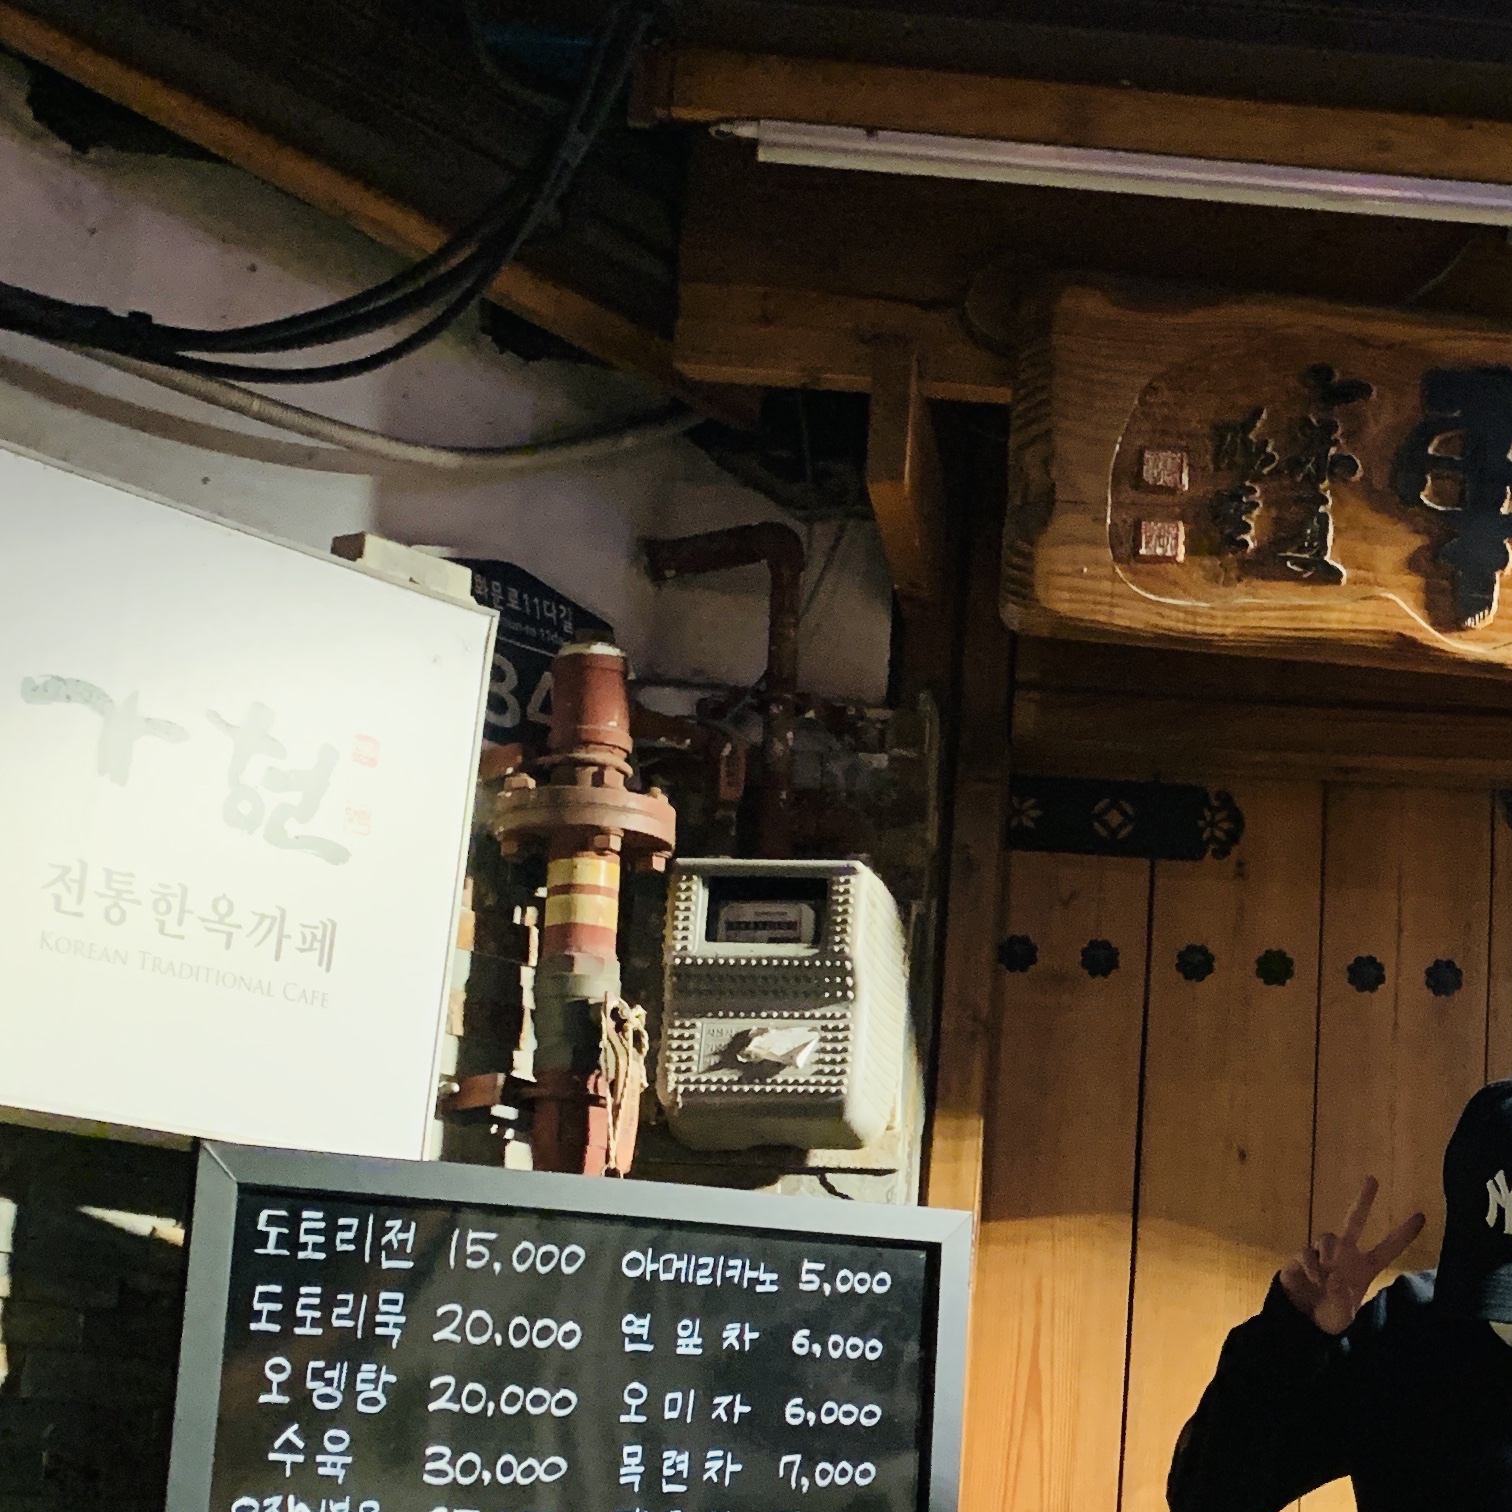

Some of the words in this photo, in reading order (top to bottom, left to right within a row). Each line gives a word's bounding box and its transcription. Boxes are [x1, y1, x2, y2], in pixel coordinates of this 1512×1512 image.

[40, 858, 339, 973] 전통한옥까페
[137, 951, 276, 998] TRADITIONAL
[282, 981, 330, 1009] CAFE
[254, 1209, 417, 1270] 도토리전
[449, 1228, 586, 1275] 15,000
[621, 1248, 779, 1294] 아메리카노
[798, 1258, 892, 1296] 5,000
[249, 1284, 406, 1350] 도토리묵
[433, 1303, 582, 1350] 20,000
[791, 1328, 884, 1361] 6,000
[427, 1375, 578, 1417] 20,000
[784, 1397, 882, 1428] 6,000
[422, 1445, 568, 1486] 30,000
[778, 1453, 876, 1494] 7,000
